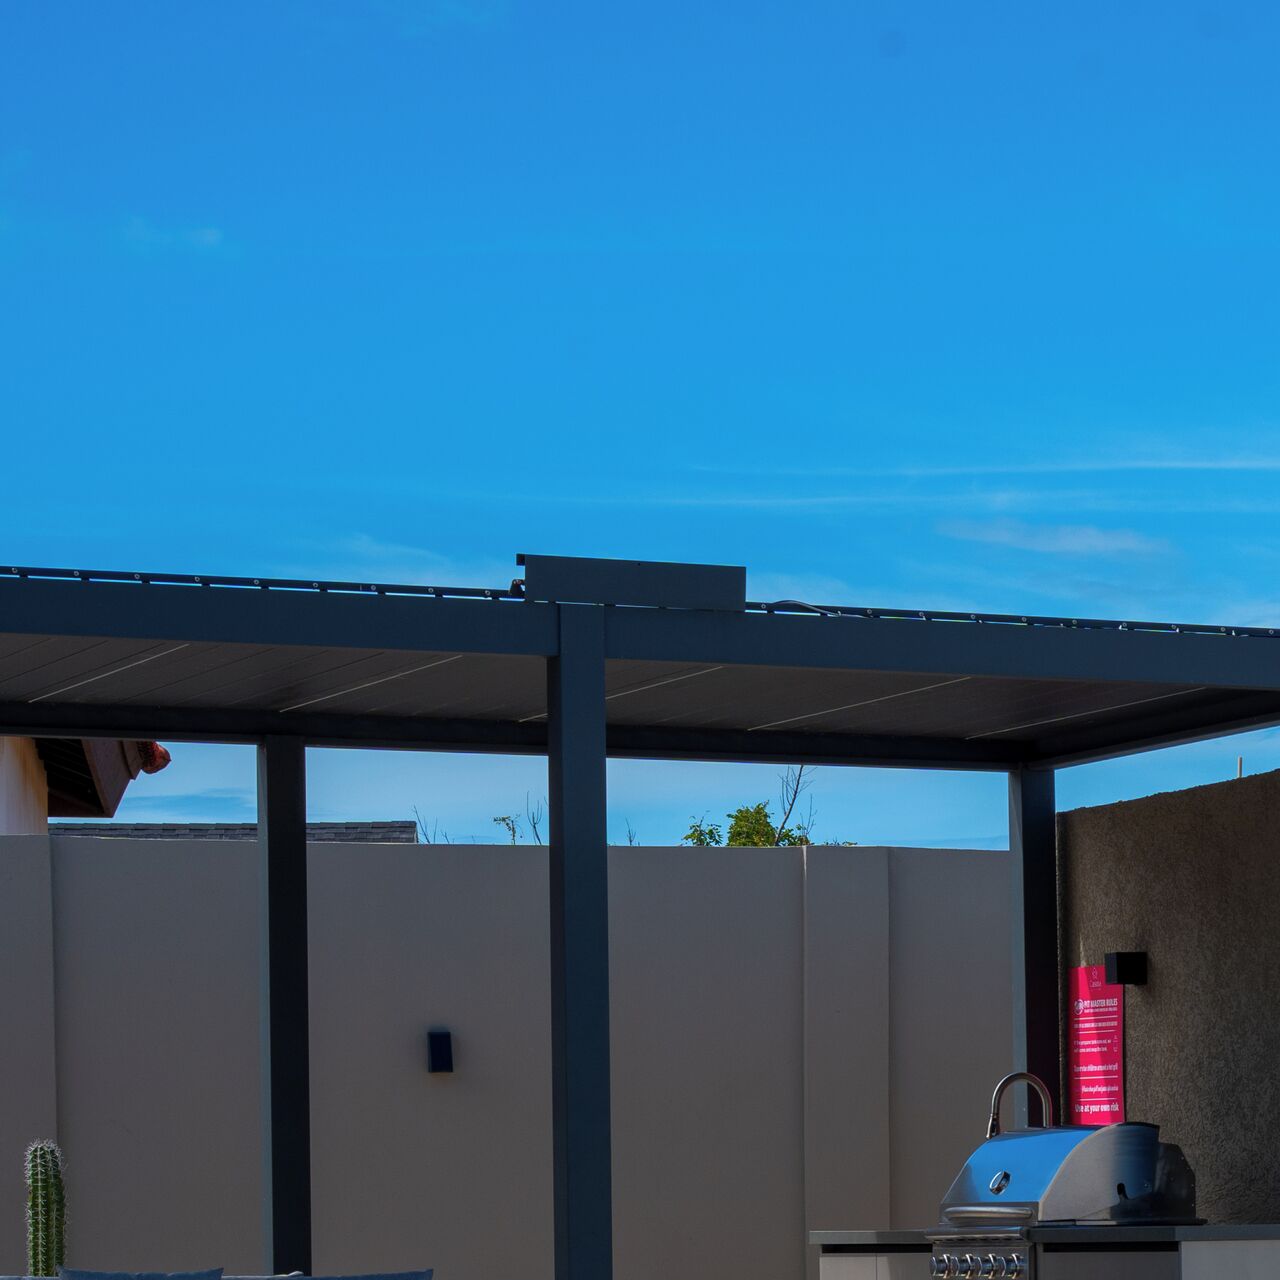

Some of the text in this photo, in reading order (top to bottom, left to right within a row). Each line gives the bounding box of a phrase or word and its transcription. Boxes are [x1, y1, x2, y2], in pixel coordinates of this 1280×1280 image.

[1084, 1104, 1089, 1112] at
[1090, 1104, 1100, 1114] your
[1111, 1102, 1119, 1112] risk
